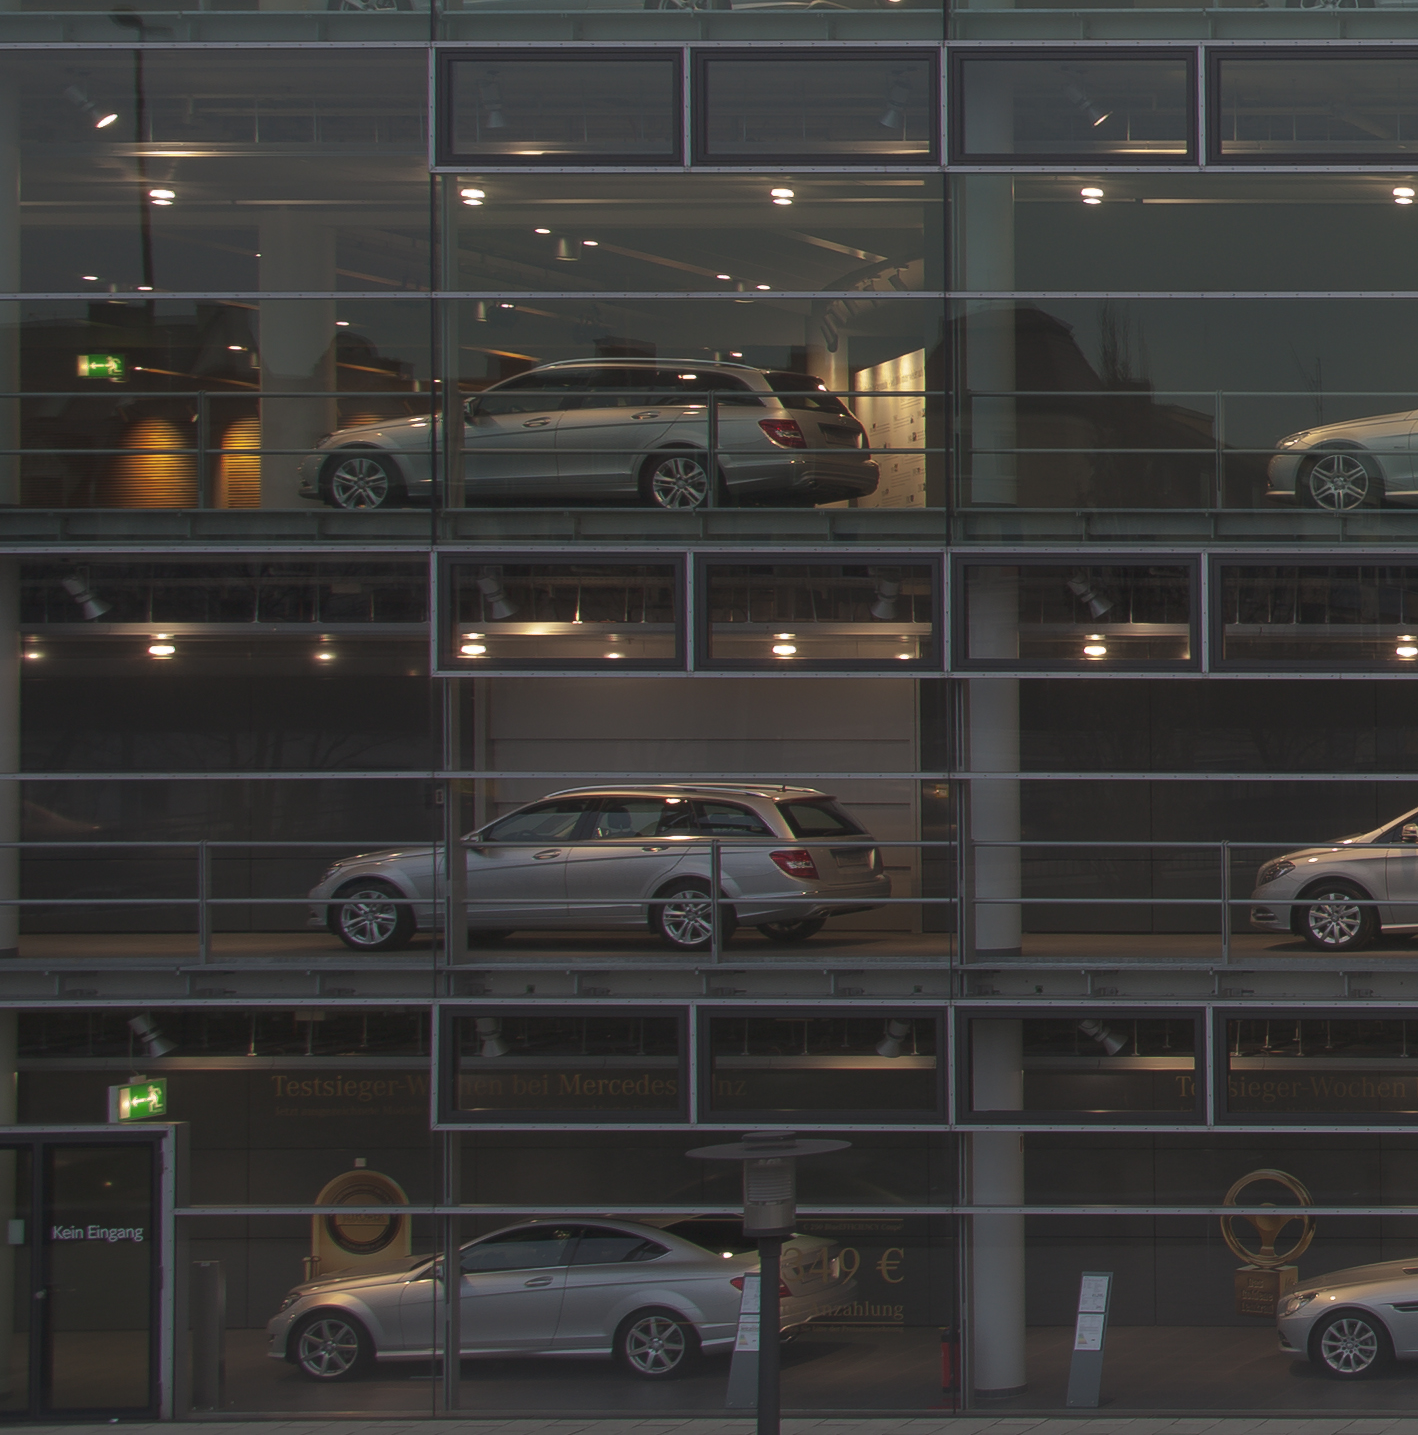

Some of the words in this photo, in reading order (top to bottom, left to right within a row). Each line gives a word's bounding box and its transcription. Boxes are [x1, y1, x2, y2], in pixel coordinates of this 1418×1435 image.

[513, 1074, 549, 1096] bei
[558, 1074, 748, 1097] Mercedesnz
[51, 1225, 84, 1241] Kein
[86, 1224, 145, 1243] Eingang
[875, 1247, 905, 1284] €
